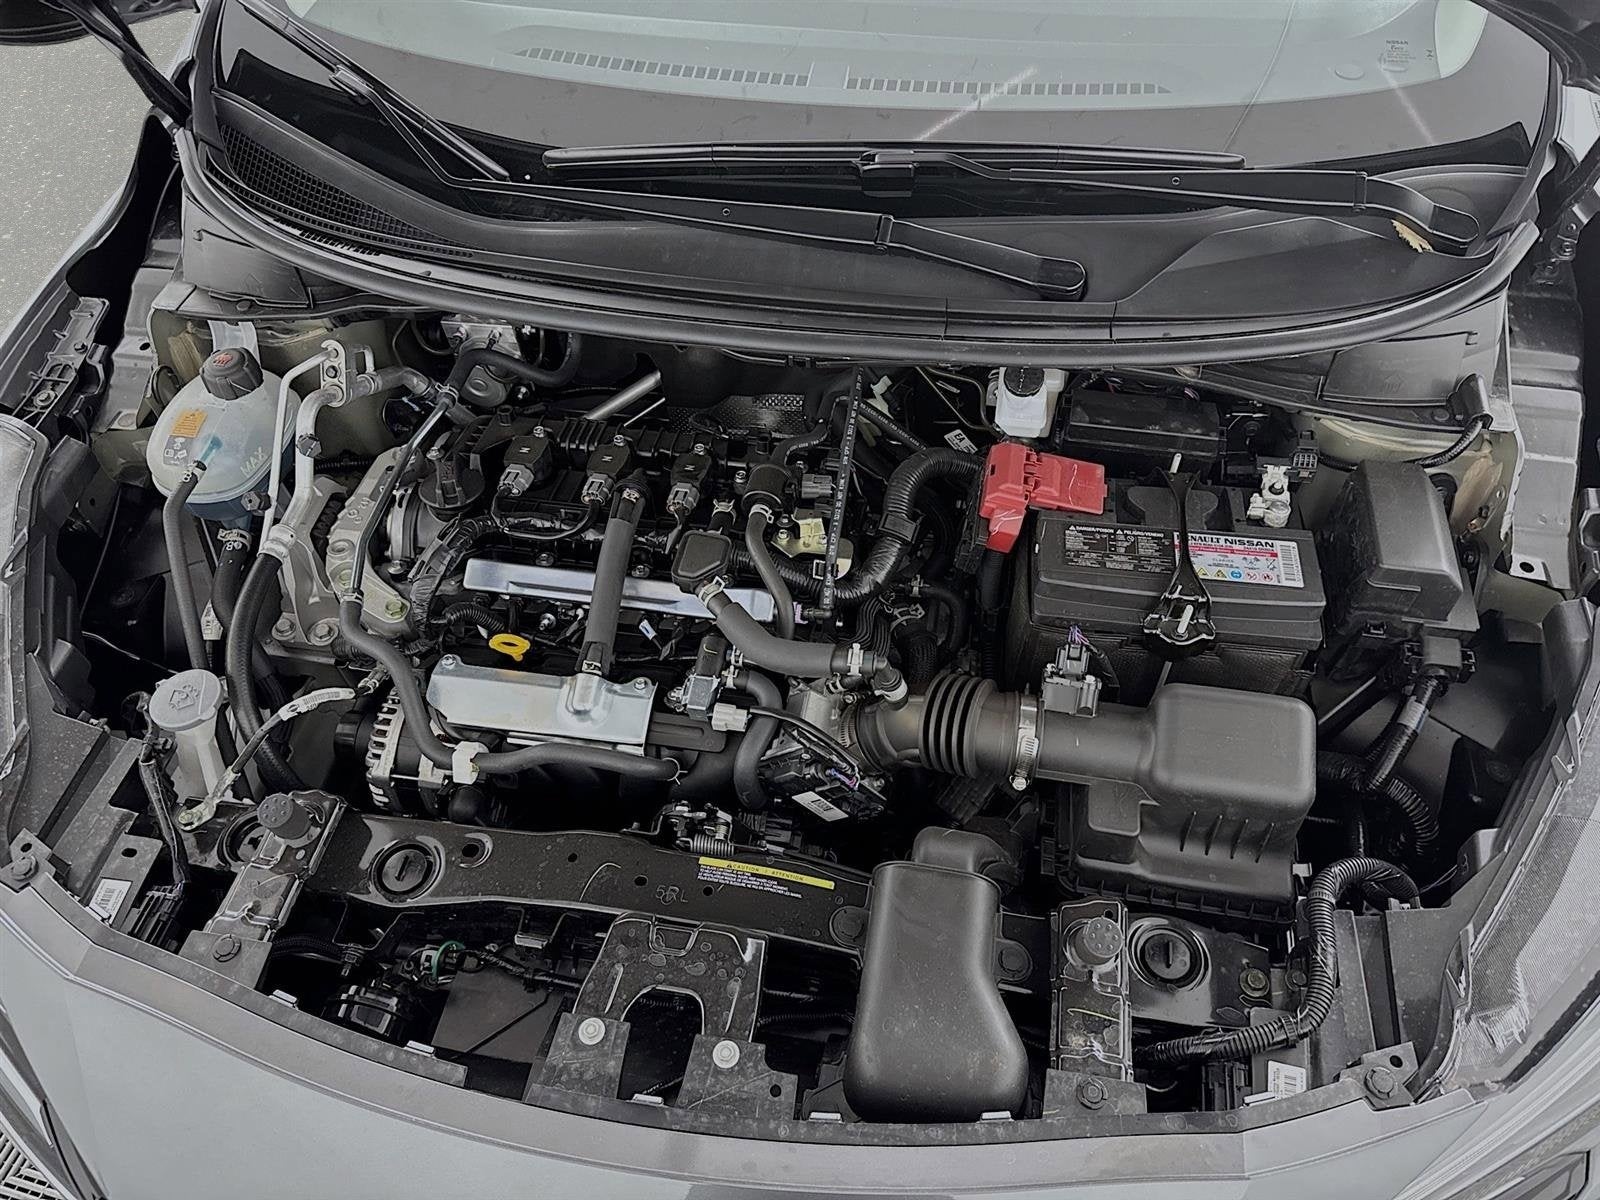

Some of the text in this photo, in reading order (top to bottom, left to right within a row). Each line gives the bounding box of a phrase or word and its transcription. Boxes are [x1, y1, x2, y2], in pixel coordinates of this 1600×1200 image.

[240, 446, 267, 478] MAX
[1177, 534, 1221, 544] NAULT
[1224, 537, 1275, 548] NISSAN
[732, 863, 760, 872] CAUTION
[771, 870, 804, 881] ATTENTION
